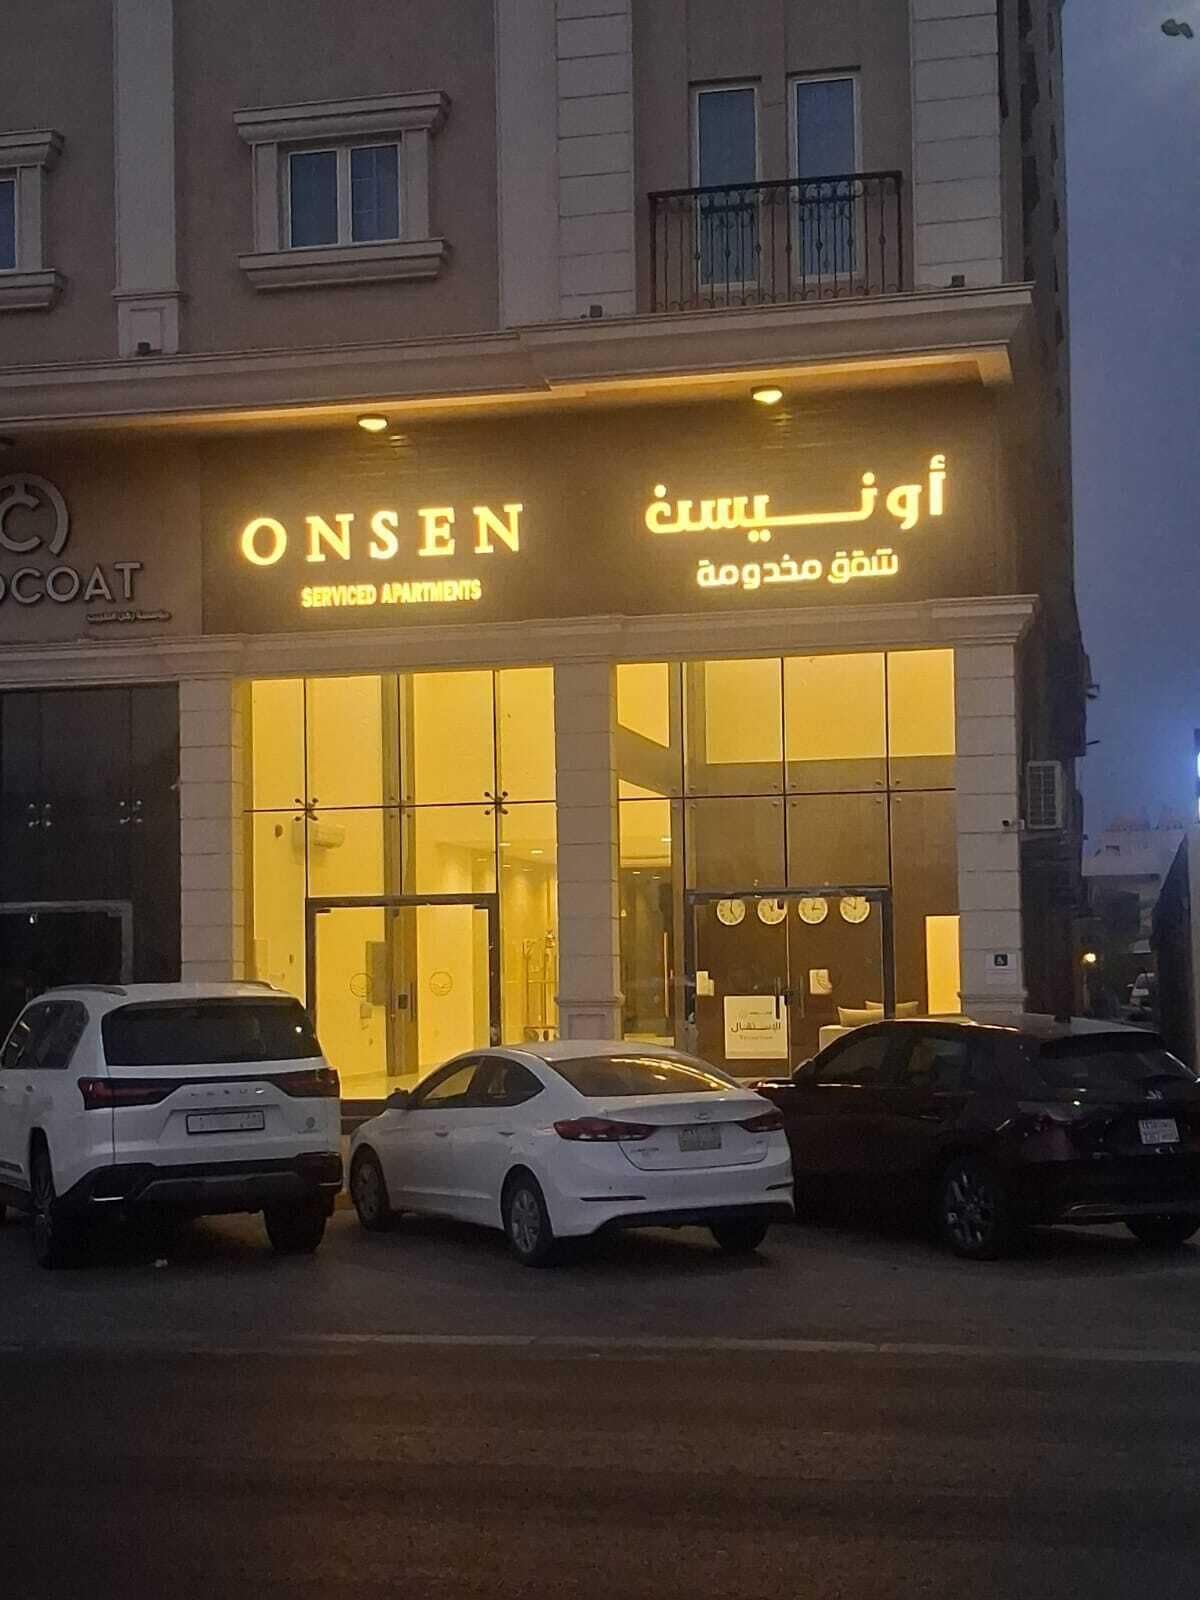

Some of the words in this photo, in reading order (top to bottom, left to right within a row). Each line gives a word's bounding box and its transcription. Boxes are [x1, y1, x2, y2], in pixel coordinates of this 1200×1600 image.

[240, 503, 524, 566] ONSEN
[0, 562, 142, 604] COAT
[696, 554, 822, 590] مخدومة
[827, 548, 899, 584] شقق
[301, 584, 377, 608] SERVICED
[381, 579, 482, 604] APARTMENTS
